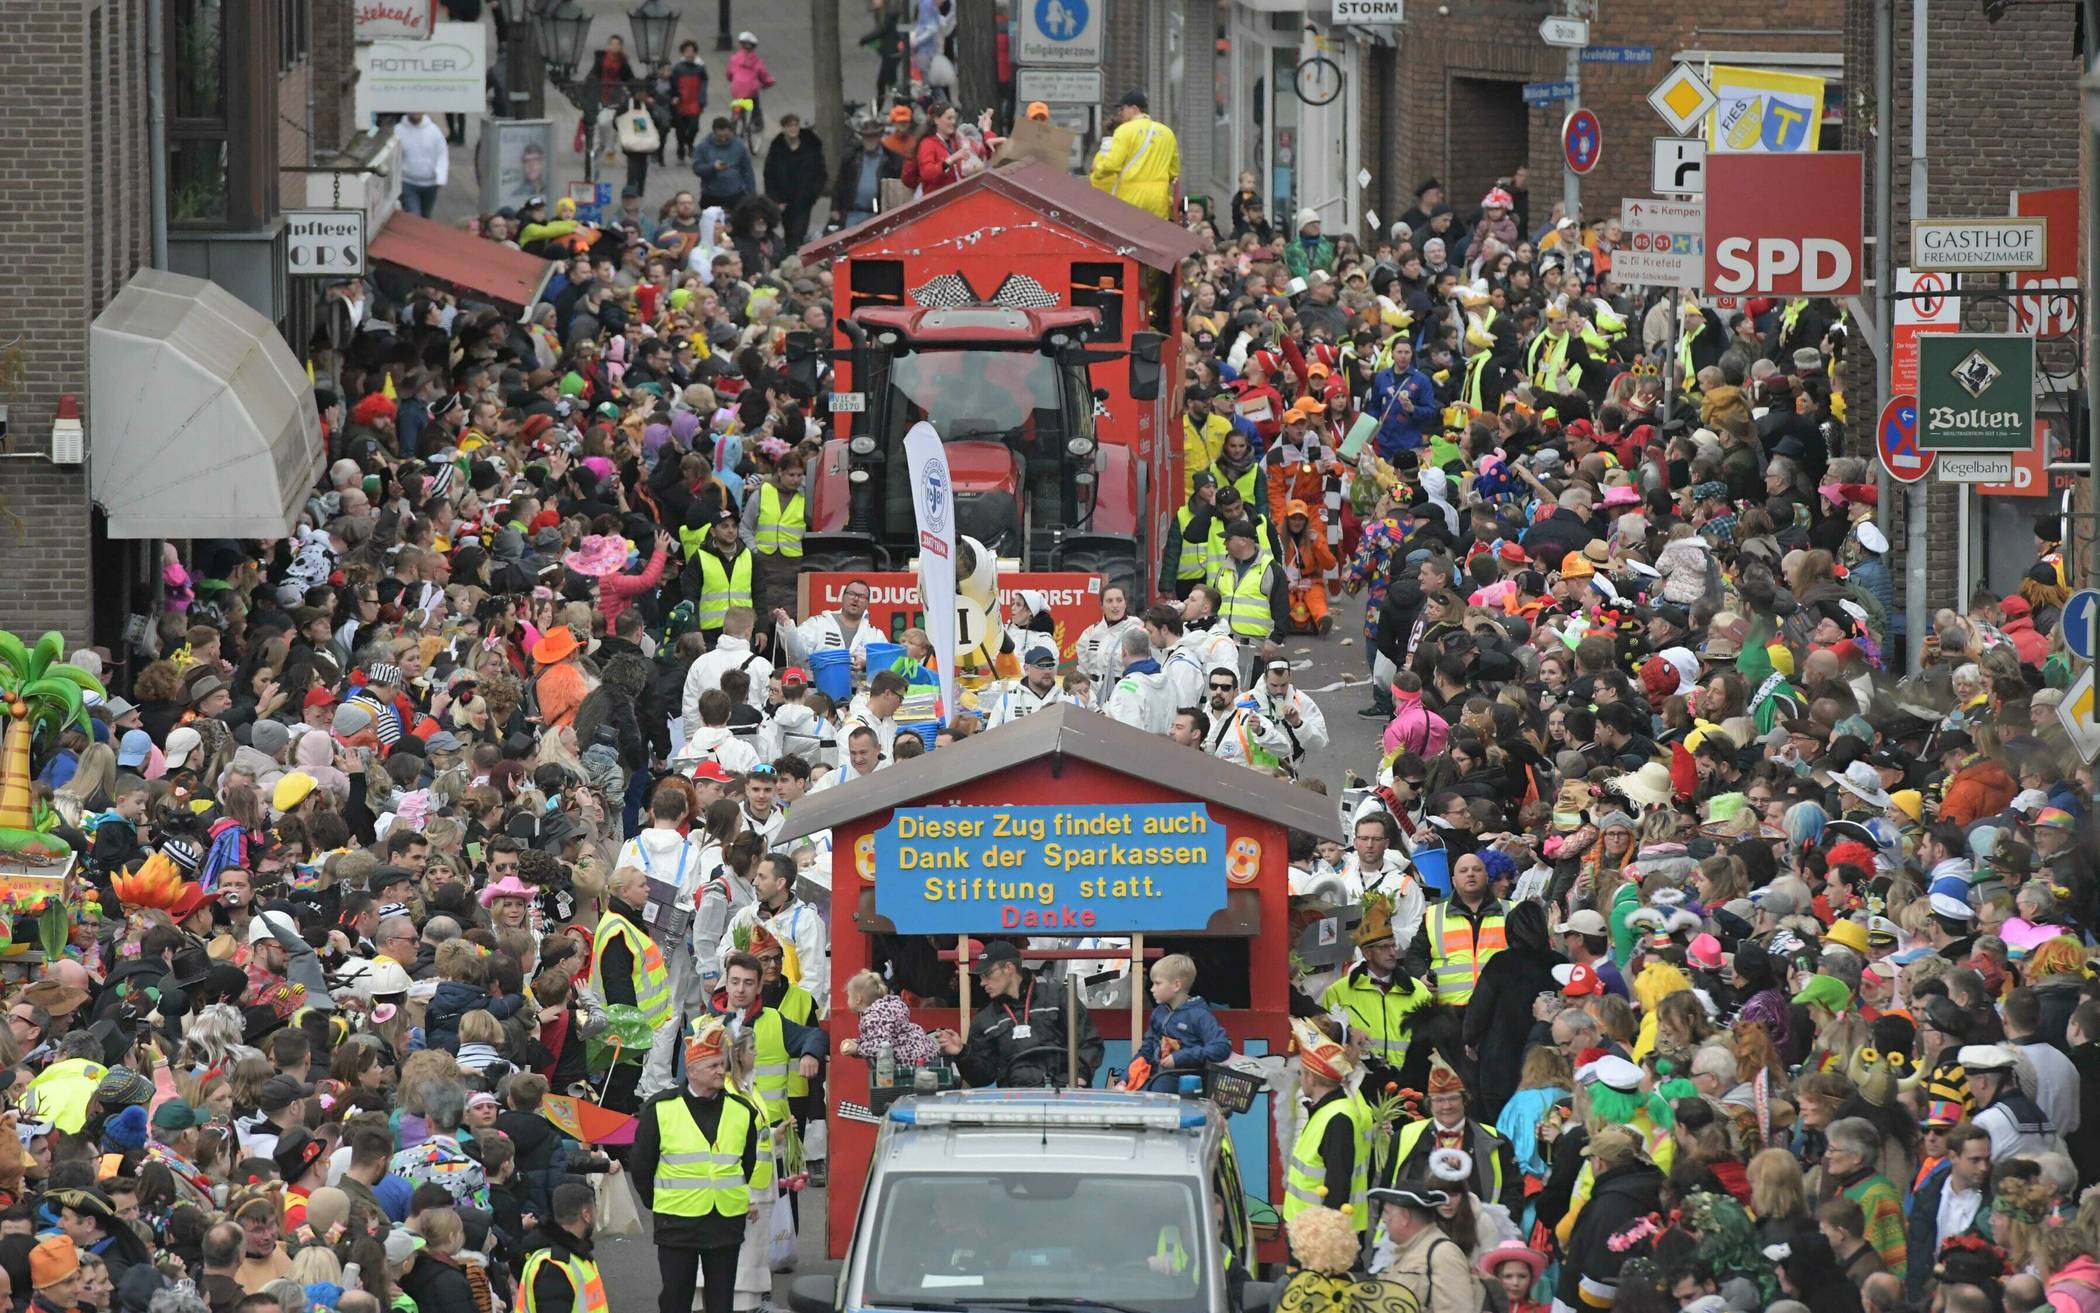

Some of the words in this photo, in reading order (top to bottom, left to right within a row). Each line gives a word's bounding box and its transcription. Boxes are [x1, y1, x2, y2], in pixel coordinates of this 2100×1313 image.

[1338, 2, 1398, 14] STORM
[1722, 100, 1748, 131] FIES
[1773, 106, 1803, 145] T
[1661, 206, 1701, 217] Kempen
[1924, 230, 2034, 248] GASTHOF
[1643, 257, 1682, 269] Krefeld
[1714, 237, 1852, 293] SPD
[1924, 251, 2034, 263] FREMDENZIMMER
[1929, 406, 2023, 430] Bolten
[1942, 461, 2008, 477] Kegelbahn
[898, 815, 983, 838] Dieser
[992, 814, 1045, 841] Zug
[1053, 812, 1131, 836] findet
[1143, 812, 1207, 834] auch
[899, 846, 969, 869] Dank
[982, 845, 1025, 868] der
[1043, 843, 1207, 871] Sparkassen
[923, 877, 1054, 904] Stiftung
[1079, 876, 1162, 898] statt.
[1001, 905, 1097, 929] Danke
